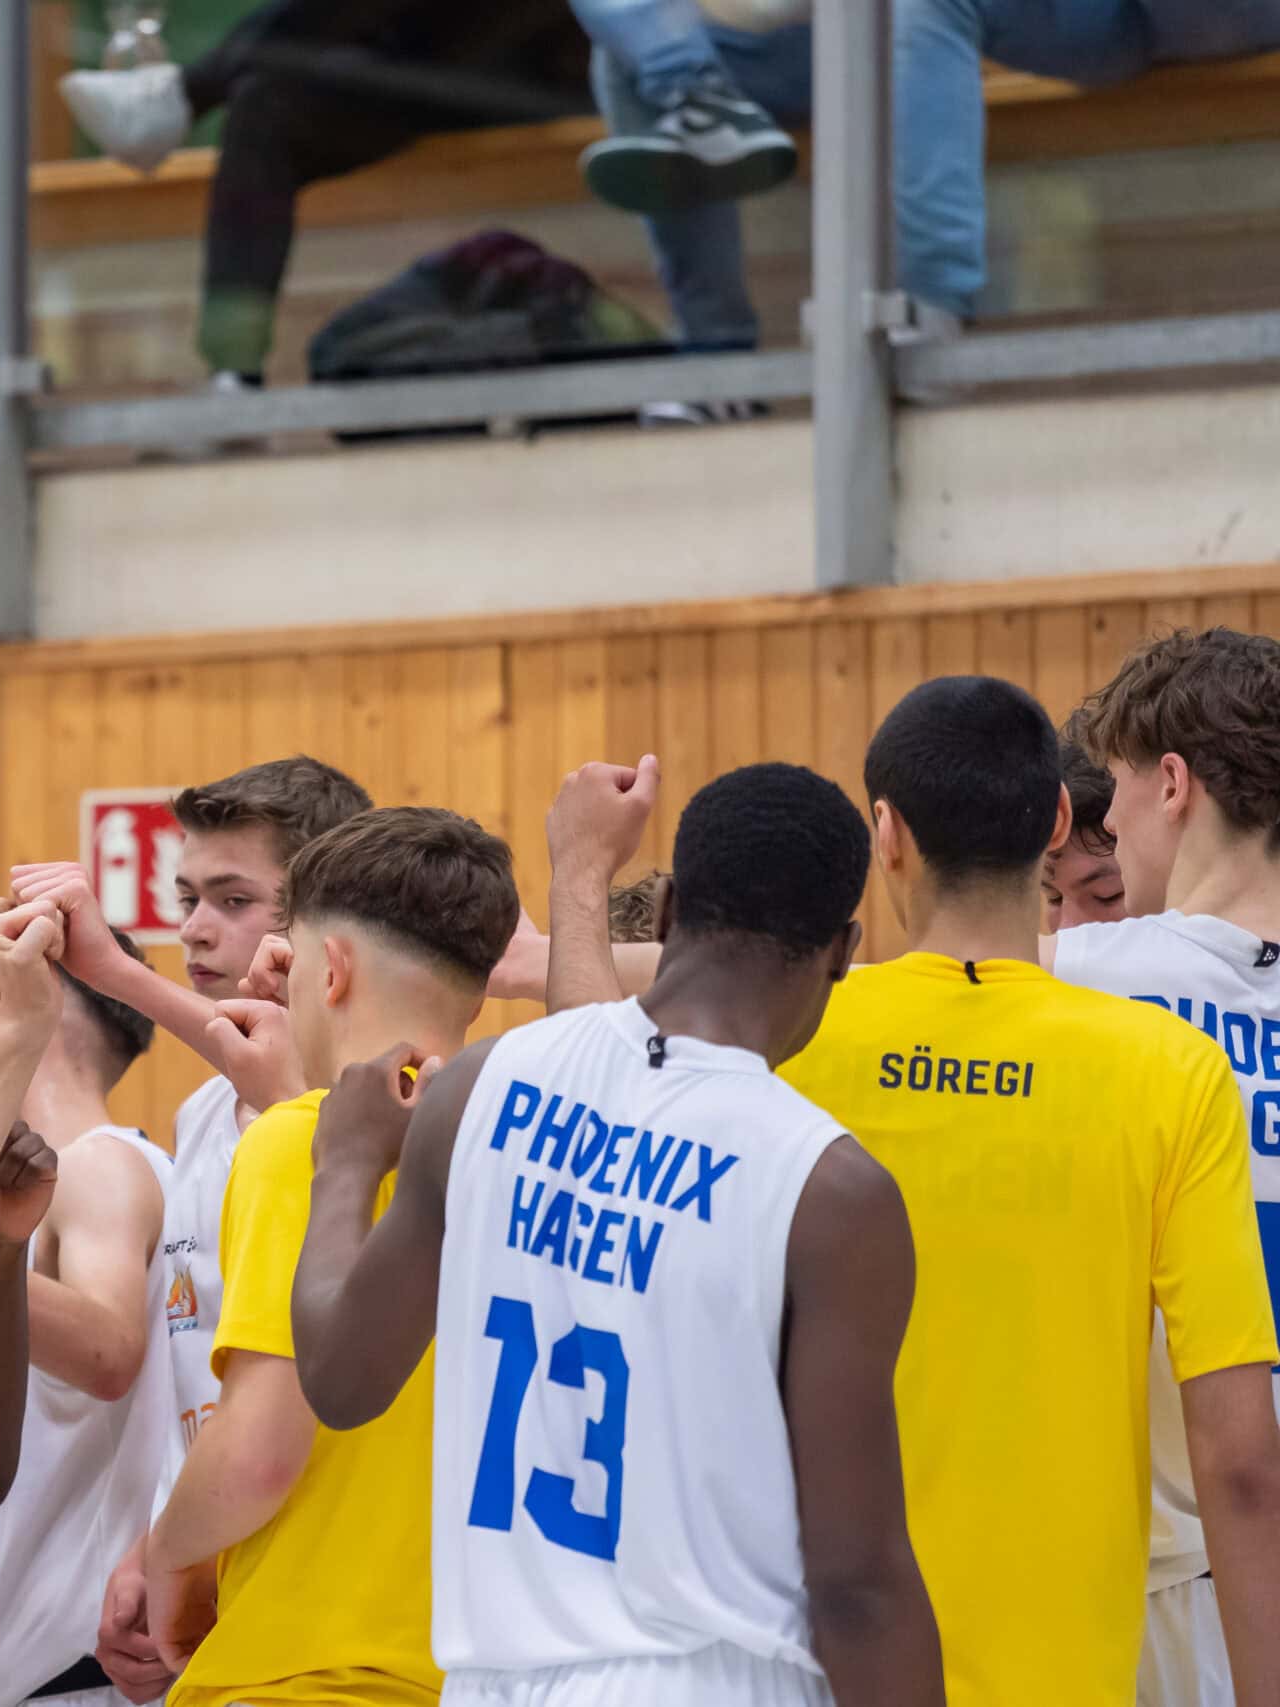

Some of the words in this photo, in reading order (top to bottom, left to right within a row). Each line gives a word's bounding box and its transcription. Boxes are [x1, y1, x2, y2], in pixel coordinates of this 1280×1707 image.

[878, 1044, 1034, 1098] SÖREGI
[489, 1080, 740, 1223] PHOENIX
[506, 1175, 664, 1294] HAGEN
[468, 1295, 630, 1562] 13
